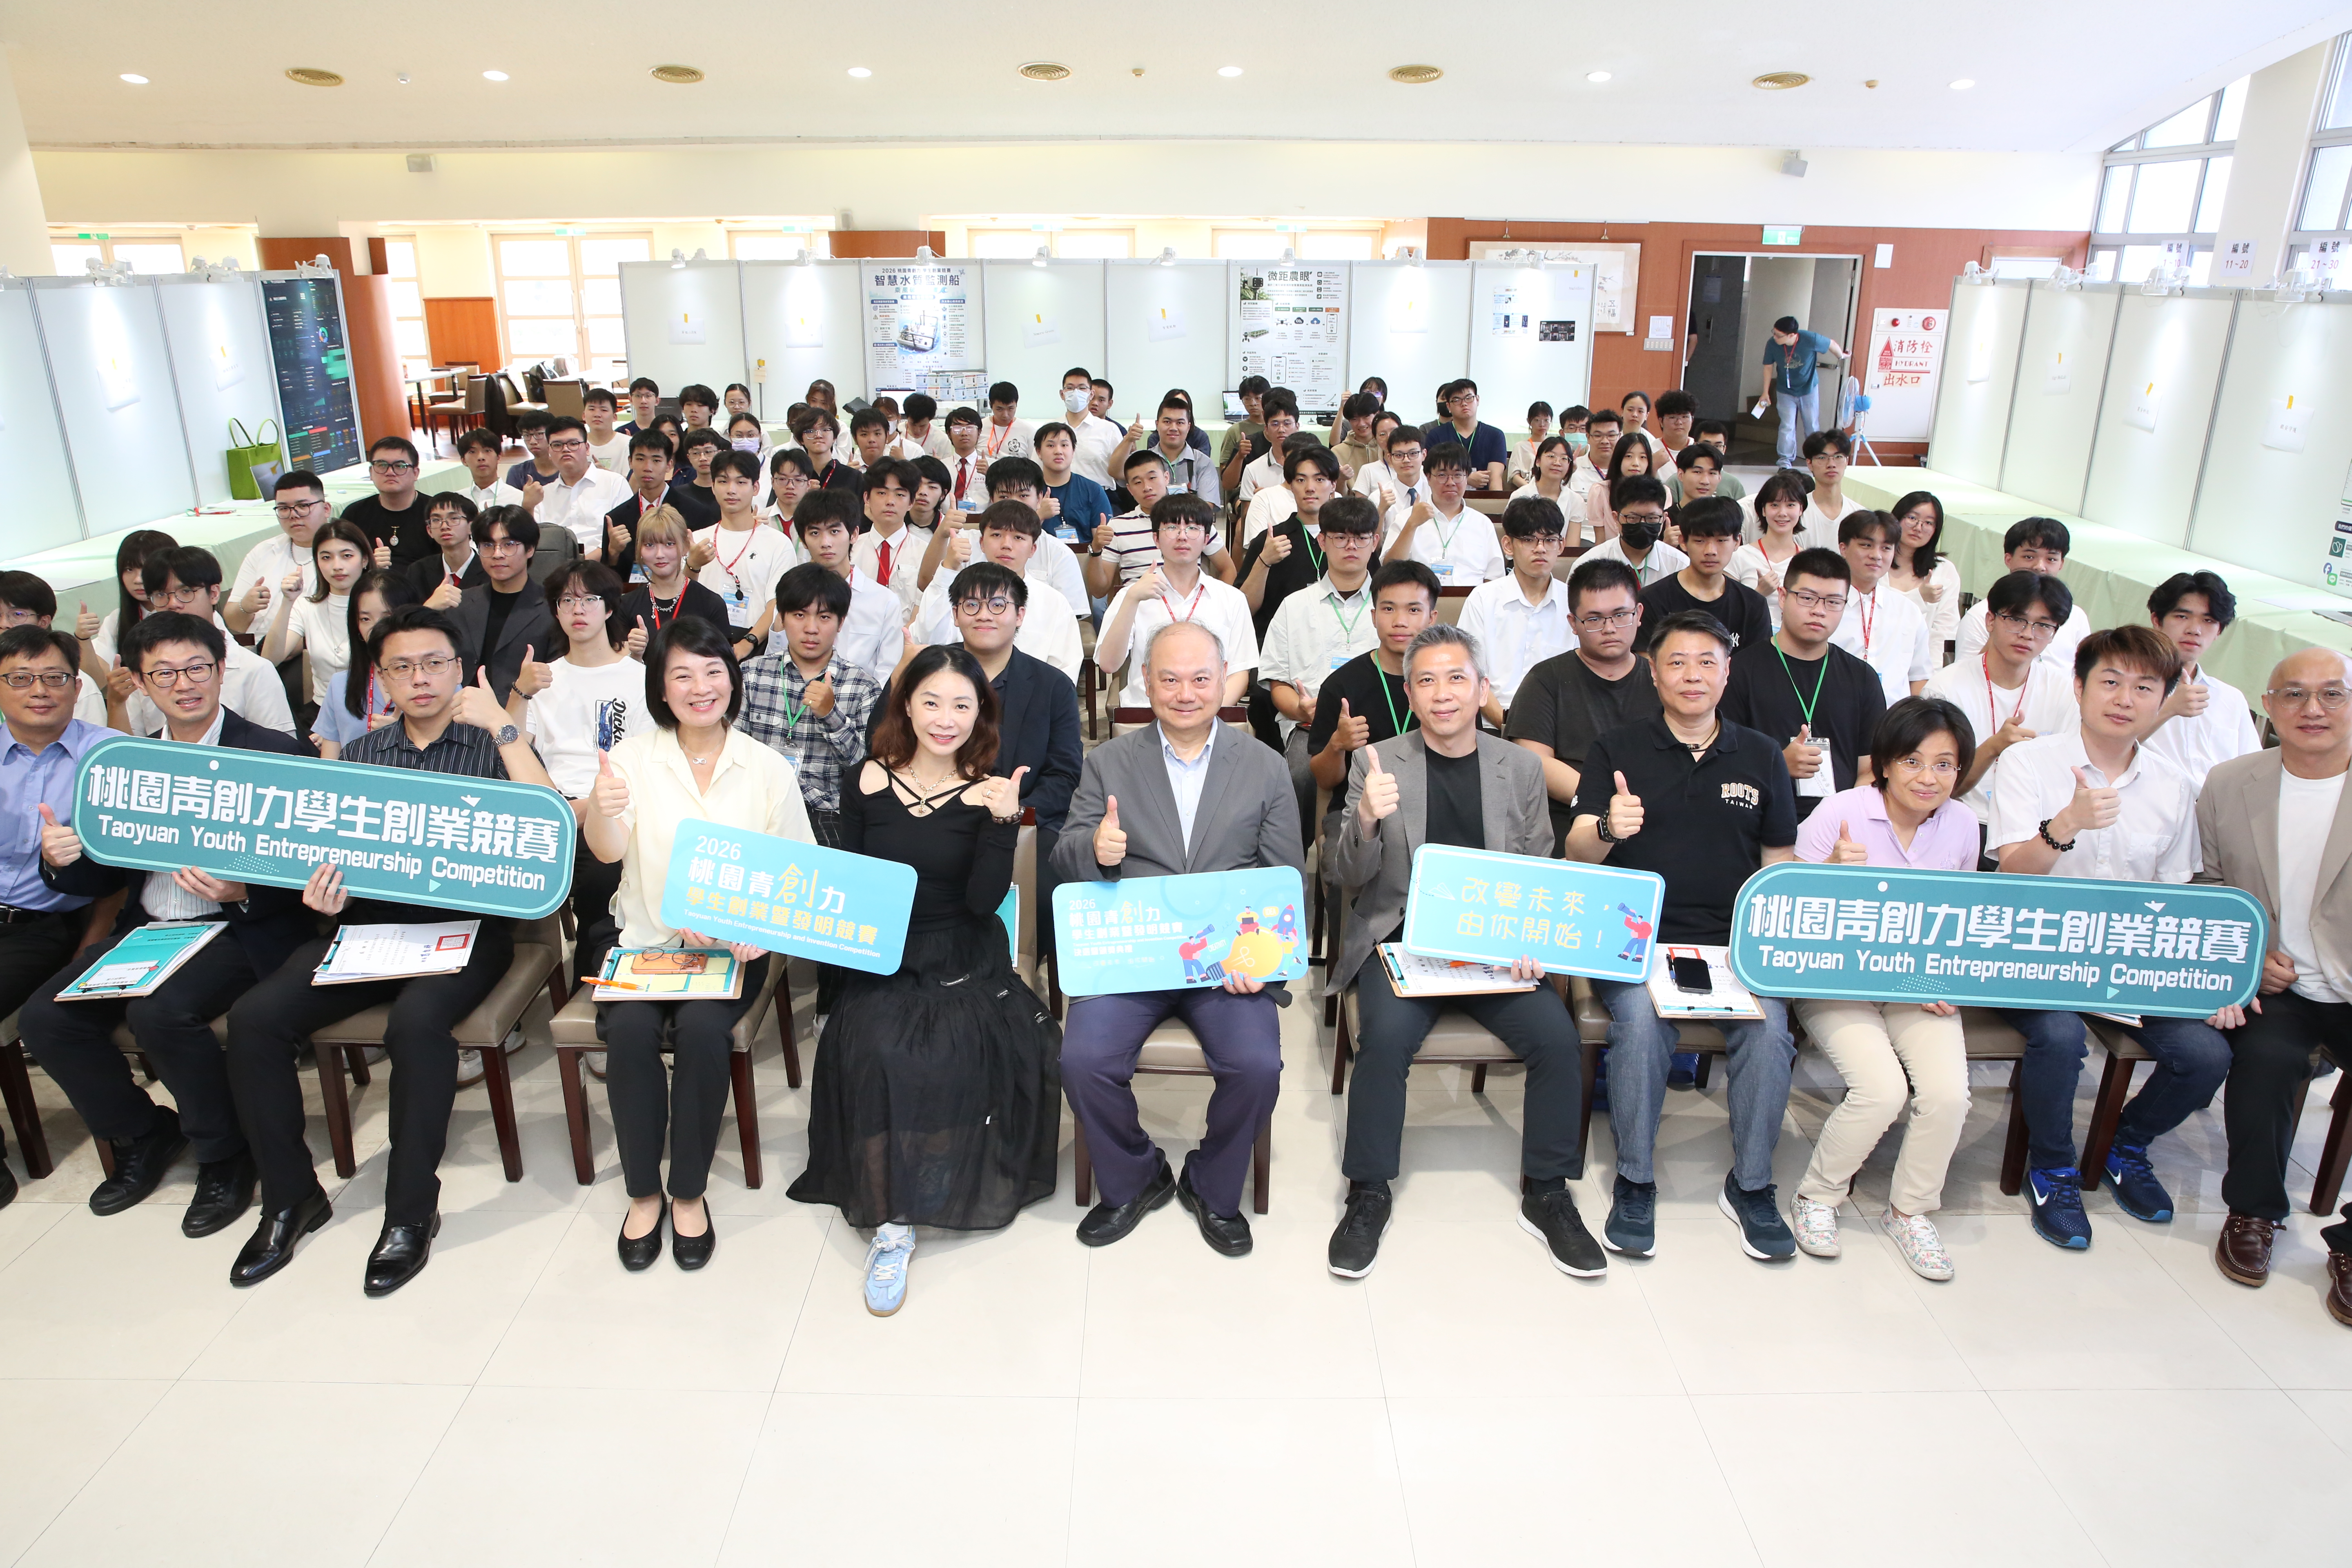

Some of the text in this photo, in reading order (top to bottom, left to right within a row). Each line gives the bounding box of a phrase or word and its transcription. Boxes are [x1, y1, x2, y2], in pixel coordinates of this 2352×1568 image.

[2167, 243, 2183, 253] 編號
[2231, 243, 2250, 254] 編號
[2319, 241, 2340, 253] 編號
[875, 274, 960, 286] 智慧水質監測船
[1268, 271, 1310, 281] 微距農眼
[1894, 339, 1933, 353] 消防栓
[1884, 373, 1920, 386] 出水口
[1721, 782, 1759, 806] ROOTS
[87, 764, 560, 863] 桃園青創力學生創業競賽
[1725, 799, 1753, 810] TAIWAN
[98, 815, 546, 891] Taoyuan Youth Entrepreneurship Competition
[695, 835, 742, 860] 2026
[688, 857, 846, 914] 桃園青創力
[1069, 899, 1096, 910] 2026
[1069, 900, 1160, 927] 桃園青創力
[686, 886, 878, 945] 學生創業暨發明競賽
[684, 909, 880, 958] Taoyuan Youth Entrepreneurship and Invention Competition
[1072, 922, 1183, 940] 學生創業暨發明競賽
[1748, 893, 2252, 964] 桃園青創力學生創業競賽
[1207, 939, 1227, 953] CREATIVITY
[1759, 944, 2232, 992] Taoyuan Youth Entrepreneurship Competition
